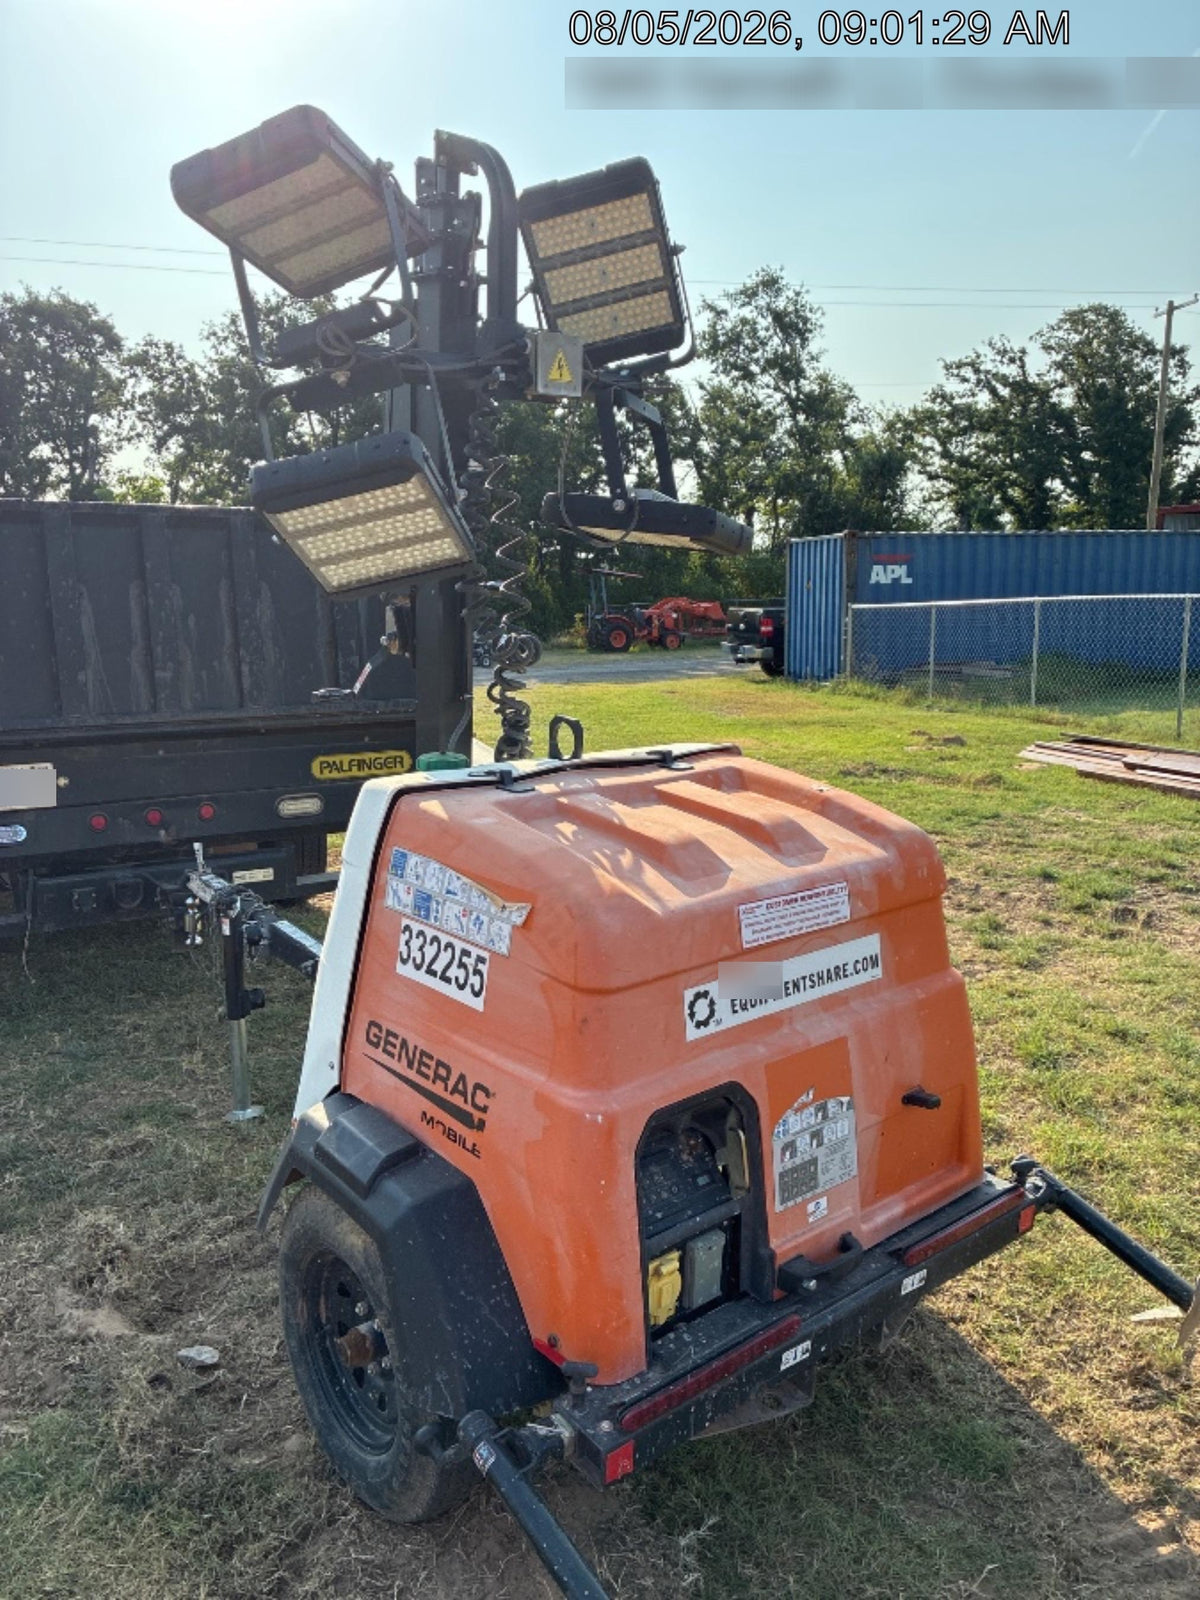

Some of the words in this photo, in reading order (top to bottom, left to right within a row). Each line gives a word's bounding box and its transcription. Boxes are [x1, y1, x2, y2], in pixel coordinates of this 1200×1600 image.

[869, 564, 913, 584] APL
[319, 755, 405, 775] PALFINGER
[399, 923, 488, 998] 332255
[730, 952, 880, 1014] EQUENTSHARE.COM
[365, 1020, 491, 1114] GENERAC
